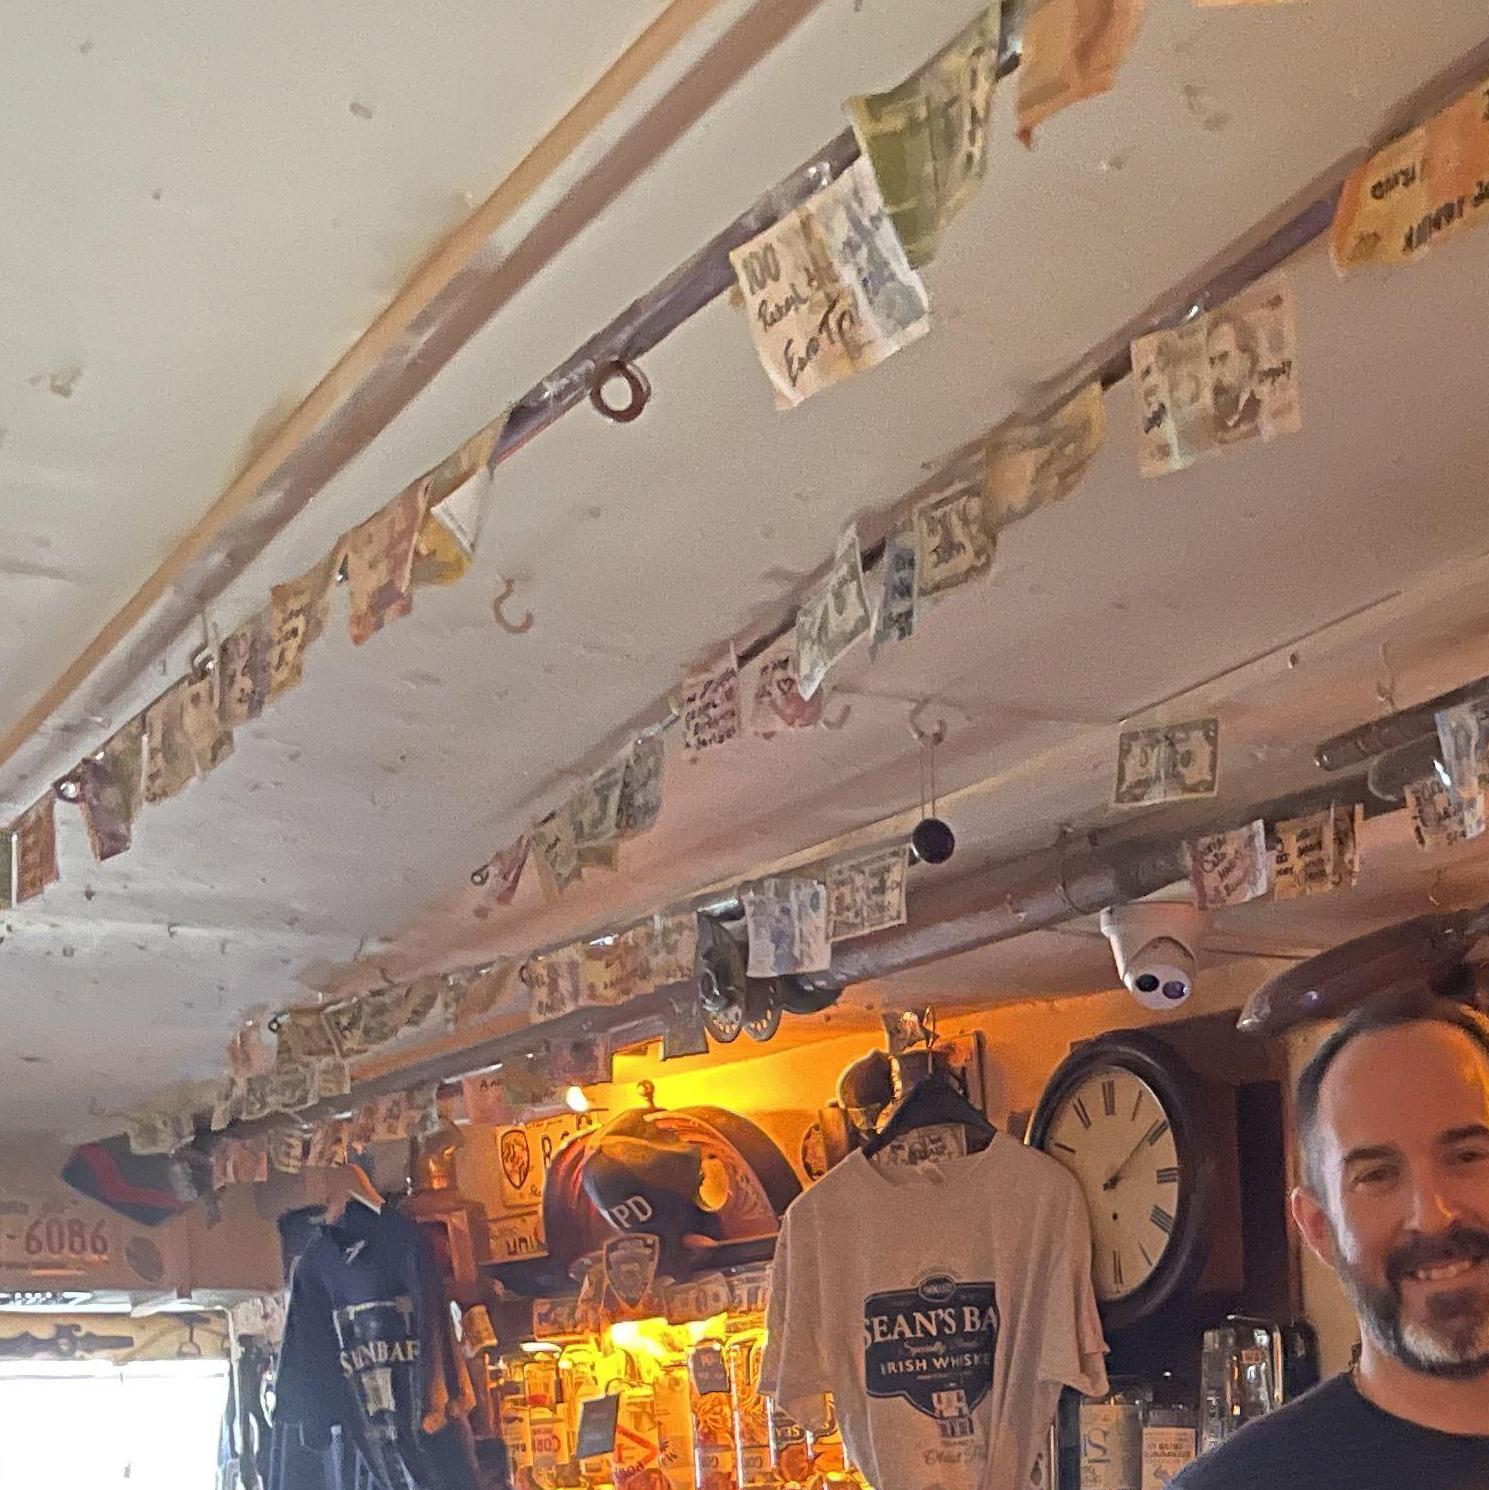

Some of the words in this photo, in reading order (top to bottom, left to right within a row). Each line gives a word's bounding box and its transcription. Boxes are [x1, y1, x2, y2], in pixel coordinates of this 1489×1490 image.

[865, 1308, 956, 1349] SEAN'S
[963, 1306, 998, 1333] BA
[880, 1358, 927, 1376] IRISH
[933, 1353, 991, 1371] WHISKE
